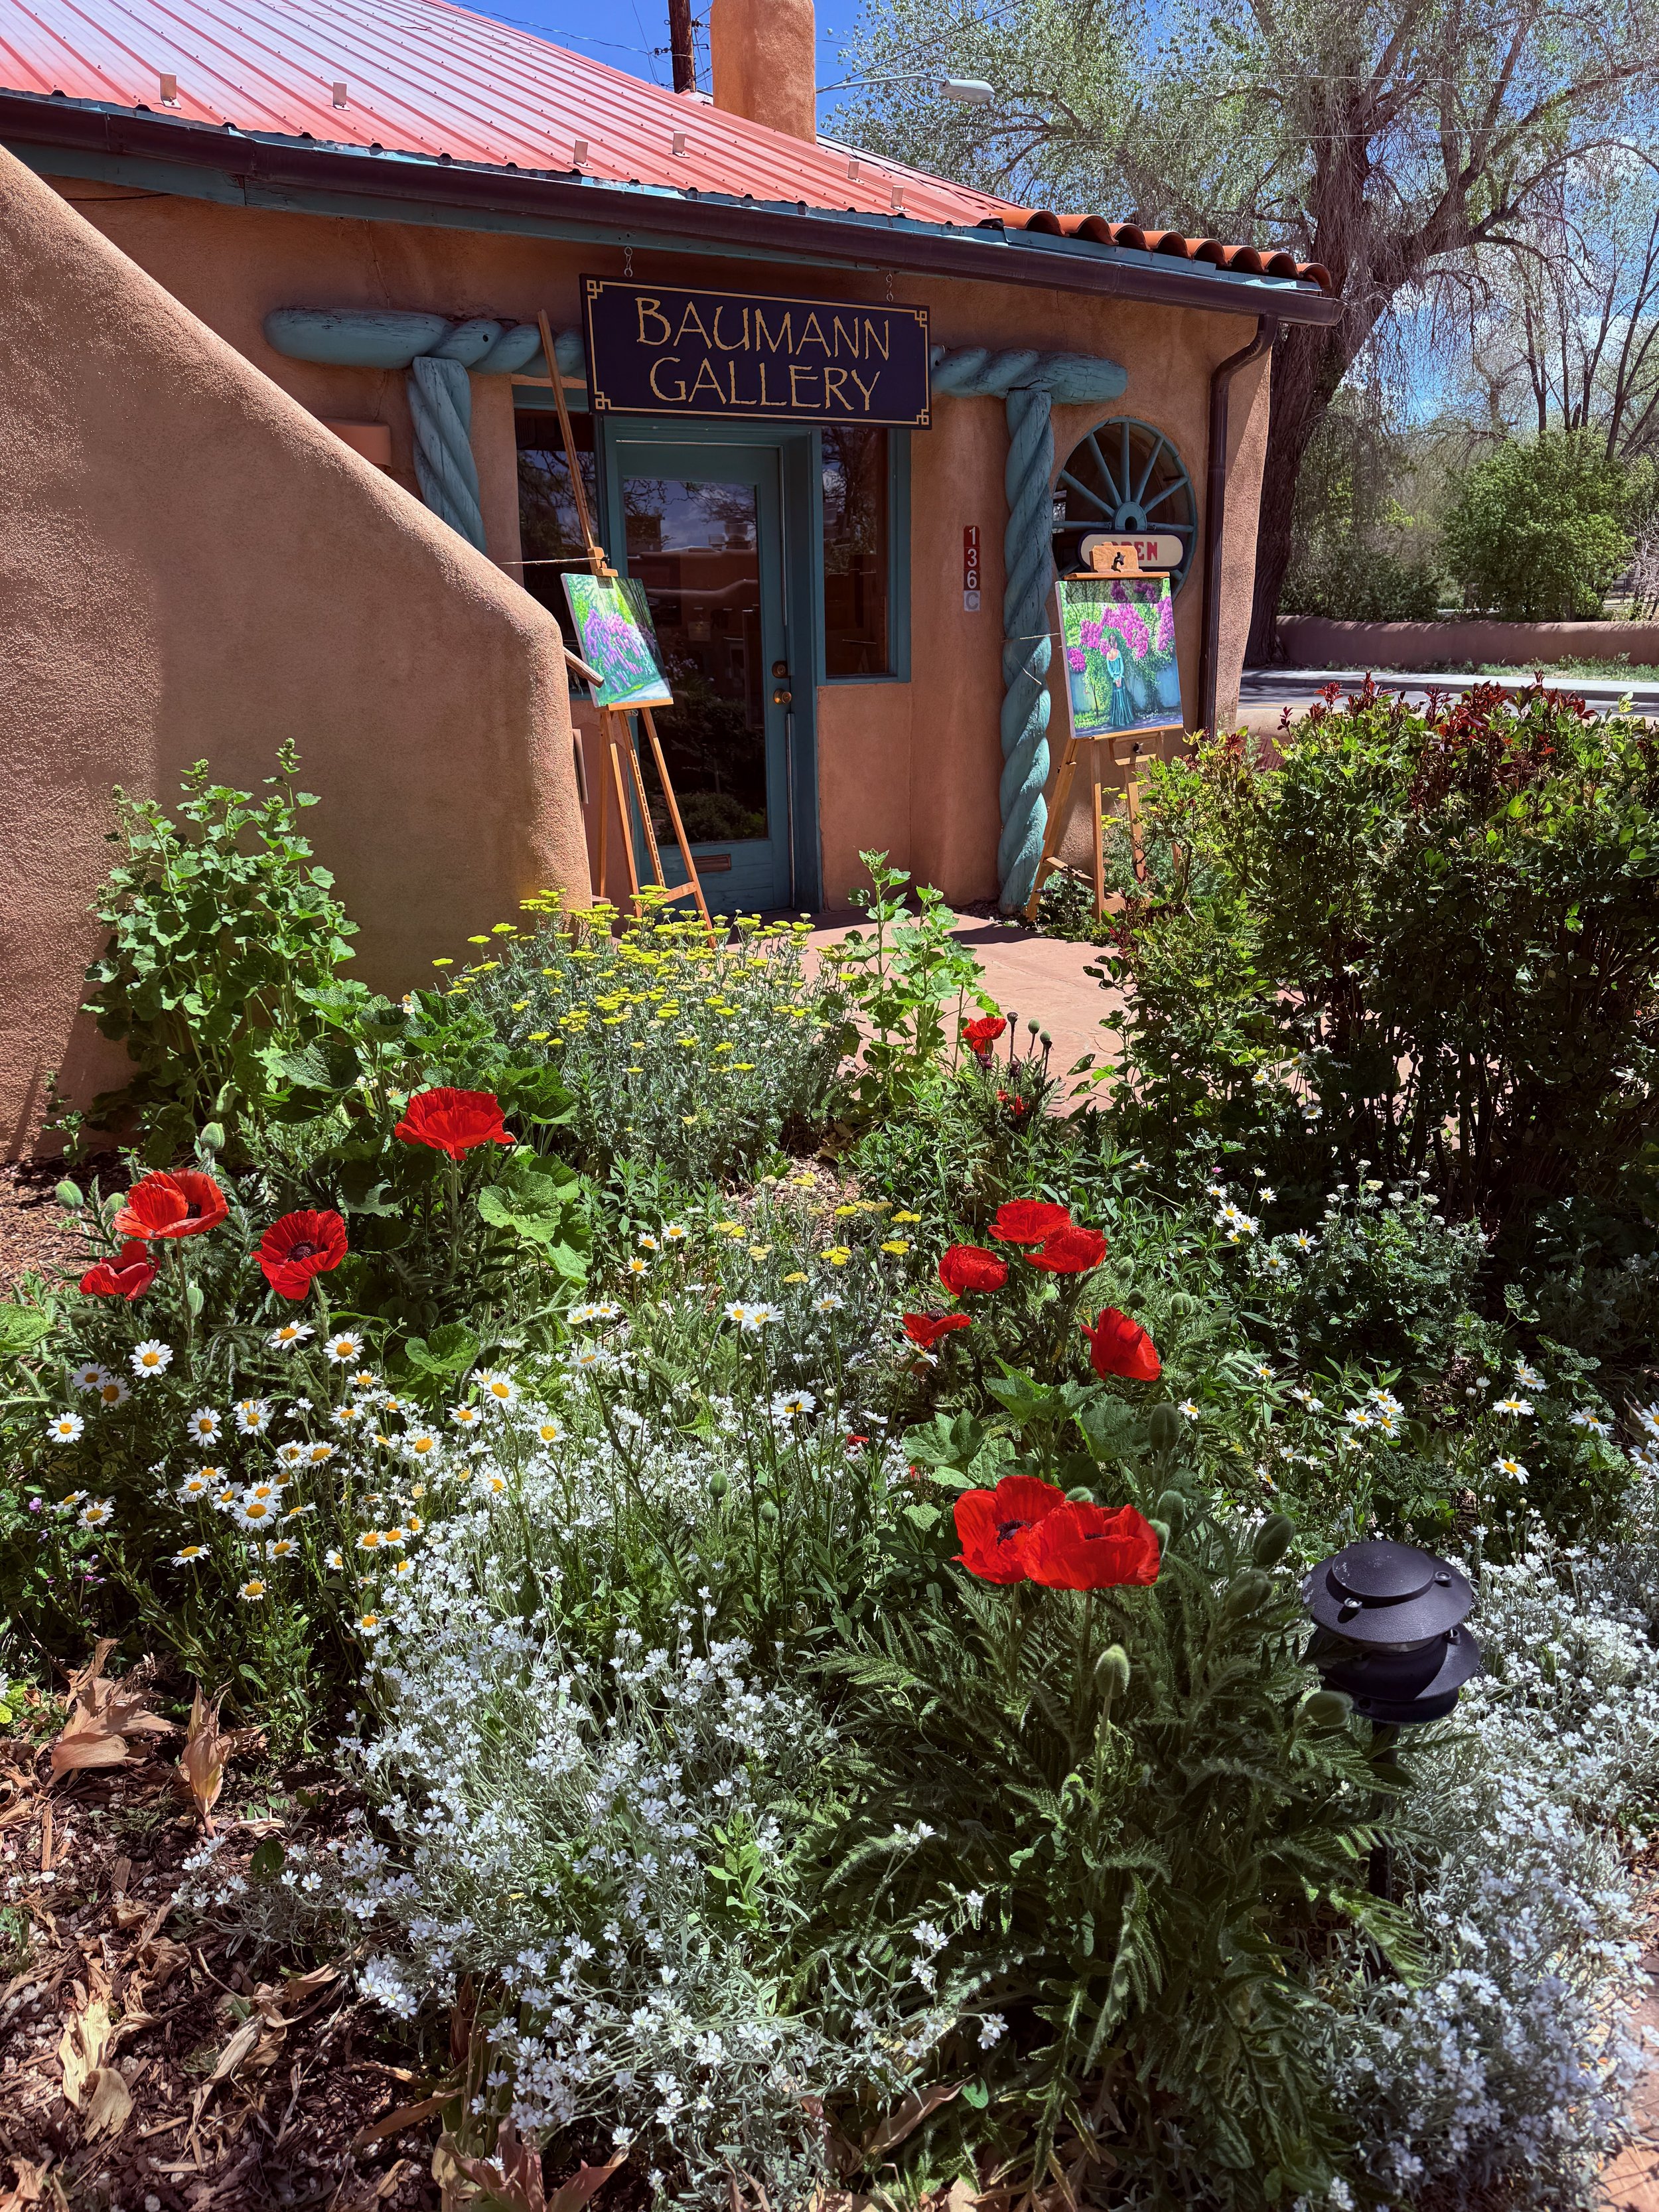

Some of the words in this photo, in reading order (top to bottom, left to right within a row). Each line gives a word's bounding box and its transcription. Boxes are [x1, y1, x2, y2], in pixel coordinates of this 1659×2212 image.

[634, 297, 890, 360] BAUMANN
[650, 356, 881, 411] GALLERY
[1110, 541, 1158, 561] EN
